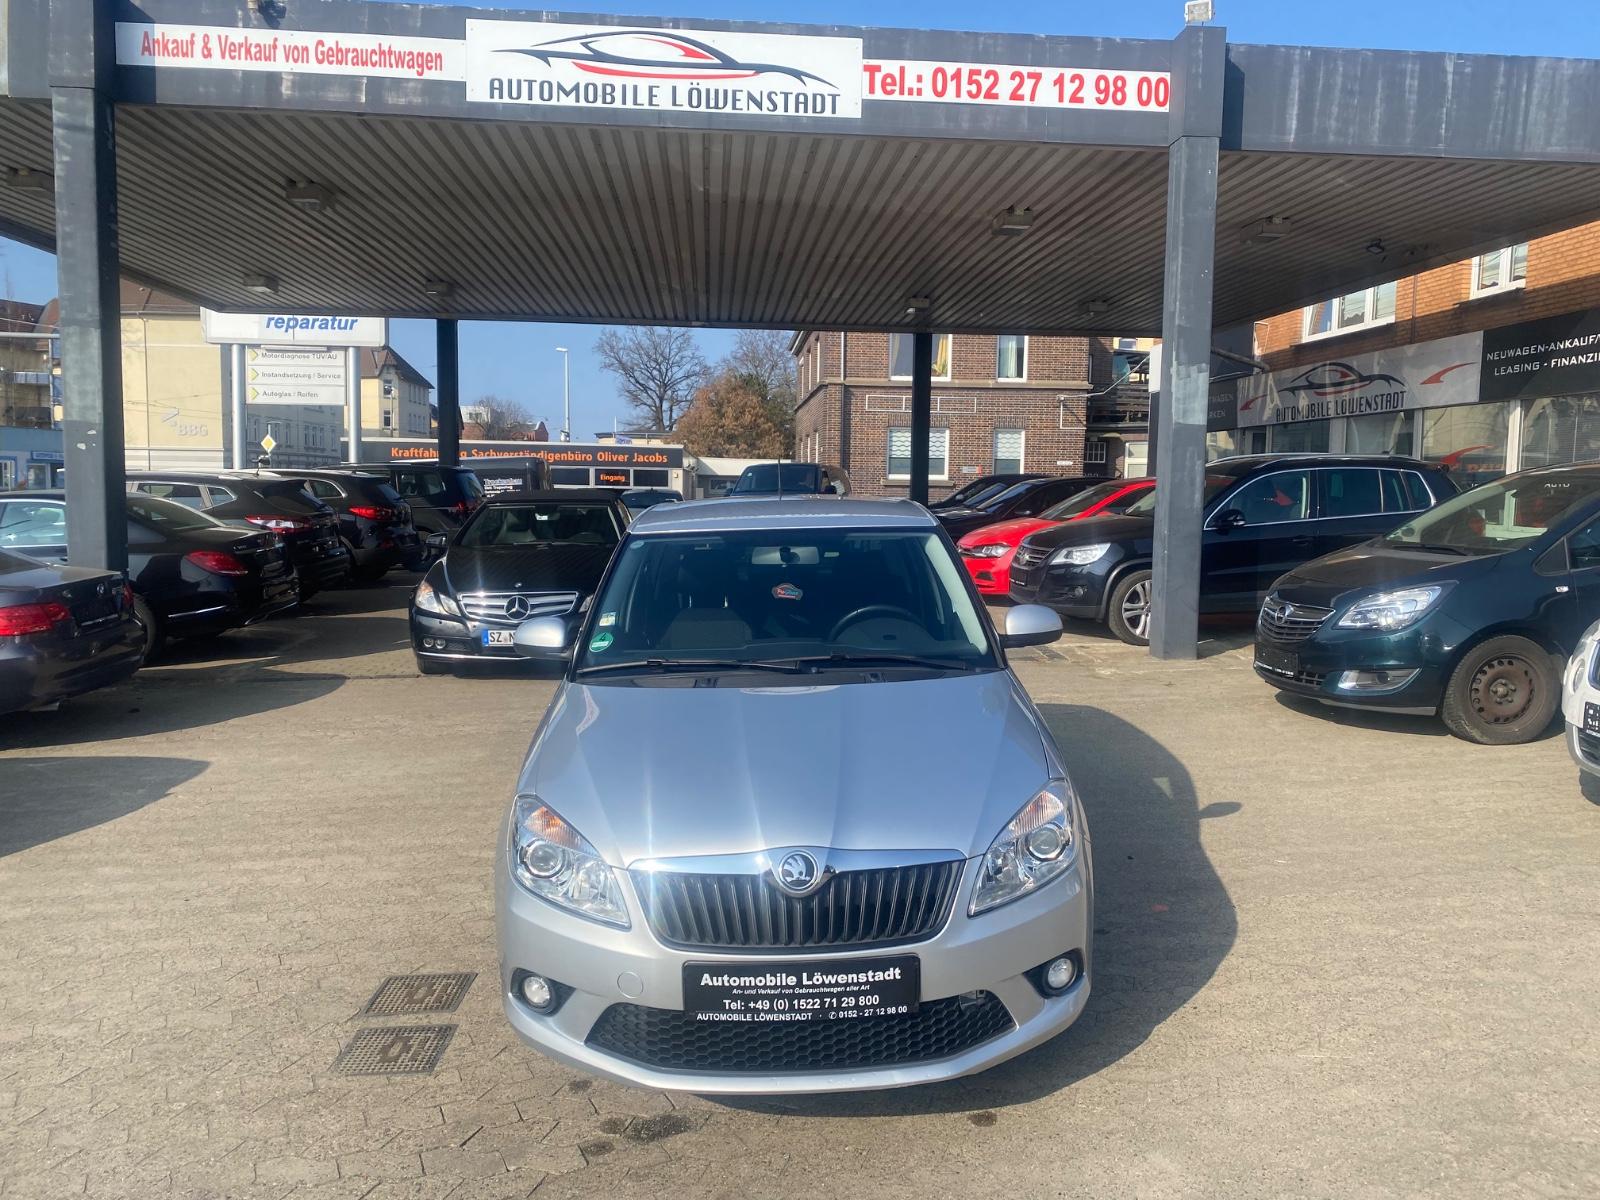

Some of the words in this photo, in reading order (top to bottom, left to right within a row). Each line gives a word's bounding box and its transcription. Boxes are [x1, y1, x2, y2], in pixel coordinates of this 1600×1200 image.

[140, 31, 196, 58] Ankauf
[201, 33, 213, 59] &
[217, 34, 278, 63] Verkauf
[282, 43, 310, 64] von
[314, 39, 443, 76] Gebrauchtwagen
[863, 64, 923, 97] Tel.:
[931, 66, 1000, 100] 0152
[1008, 70, 1043, 102] 27
[1053, 73, 1085, 104] 12
[1094, 74, 1128, 107] 98
[1137, 76, 1170, 108] 00
[489, 77, 661, 108] AUTOMOBILE
[671, 82, 841, 116] LÖWENSTADT
[265, 315, 360, 333] reparatur
[261, 352, 310, 360] Motordiagnose
[261, 371, 312, 379] Instandsetzung
[1494, 361, 1540, 376] LEASING
[262, 390, 292, 398] Autoglas
[1276, 400, 1332, 422] AUTOMOBILE
[1335, 390, 1407, 416] LÖWENSTADT
[597, 451, 628, 462] Oliver
[632, 452, 668, 463] Jacobs
[600, 474, 626, 482] Eingang
[700, 973, 798, 987] Automobile
[802, 966, 902, 985] Löwenstadt
[794, 986, 845, 994] Gebrauchtwagen
[722, 999, 745, 1010] Tel:
[748, 999, 770, 1010] +49
[773, 998, 789, 1011] (0)
[792, 998, 820, 1009] 1522
[823, 997, 837, 1008] 71
[841, 996, 856, 1007] 29
[858, 994, 880, 1006] 800
[696, 1013, 753, 1021] AUTOMOBILE
[754, 1011, 812, 1021] LÖWENSTADT
[838, 1009, 858, 1018] 0152
[864, 1008, 874, 1017] 27
[876, 1007, 885, 1015] 12
[887, 1006, 896, 1014] 98
[898, 1005, 908, 1013] 00
